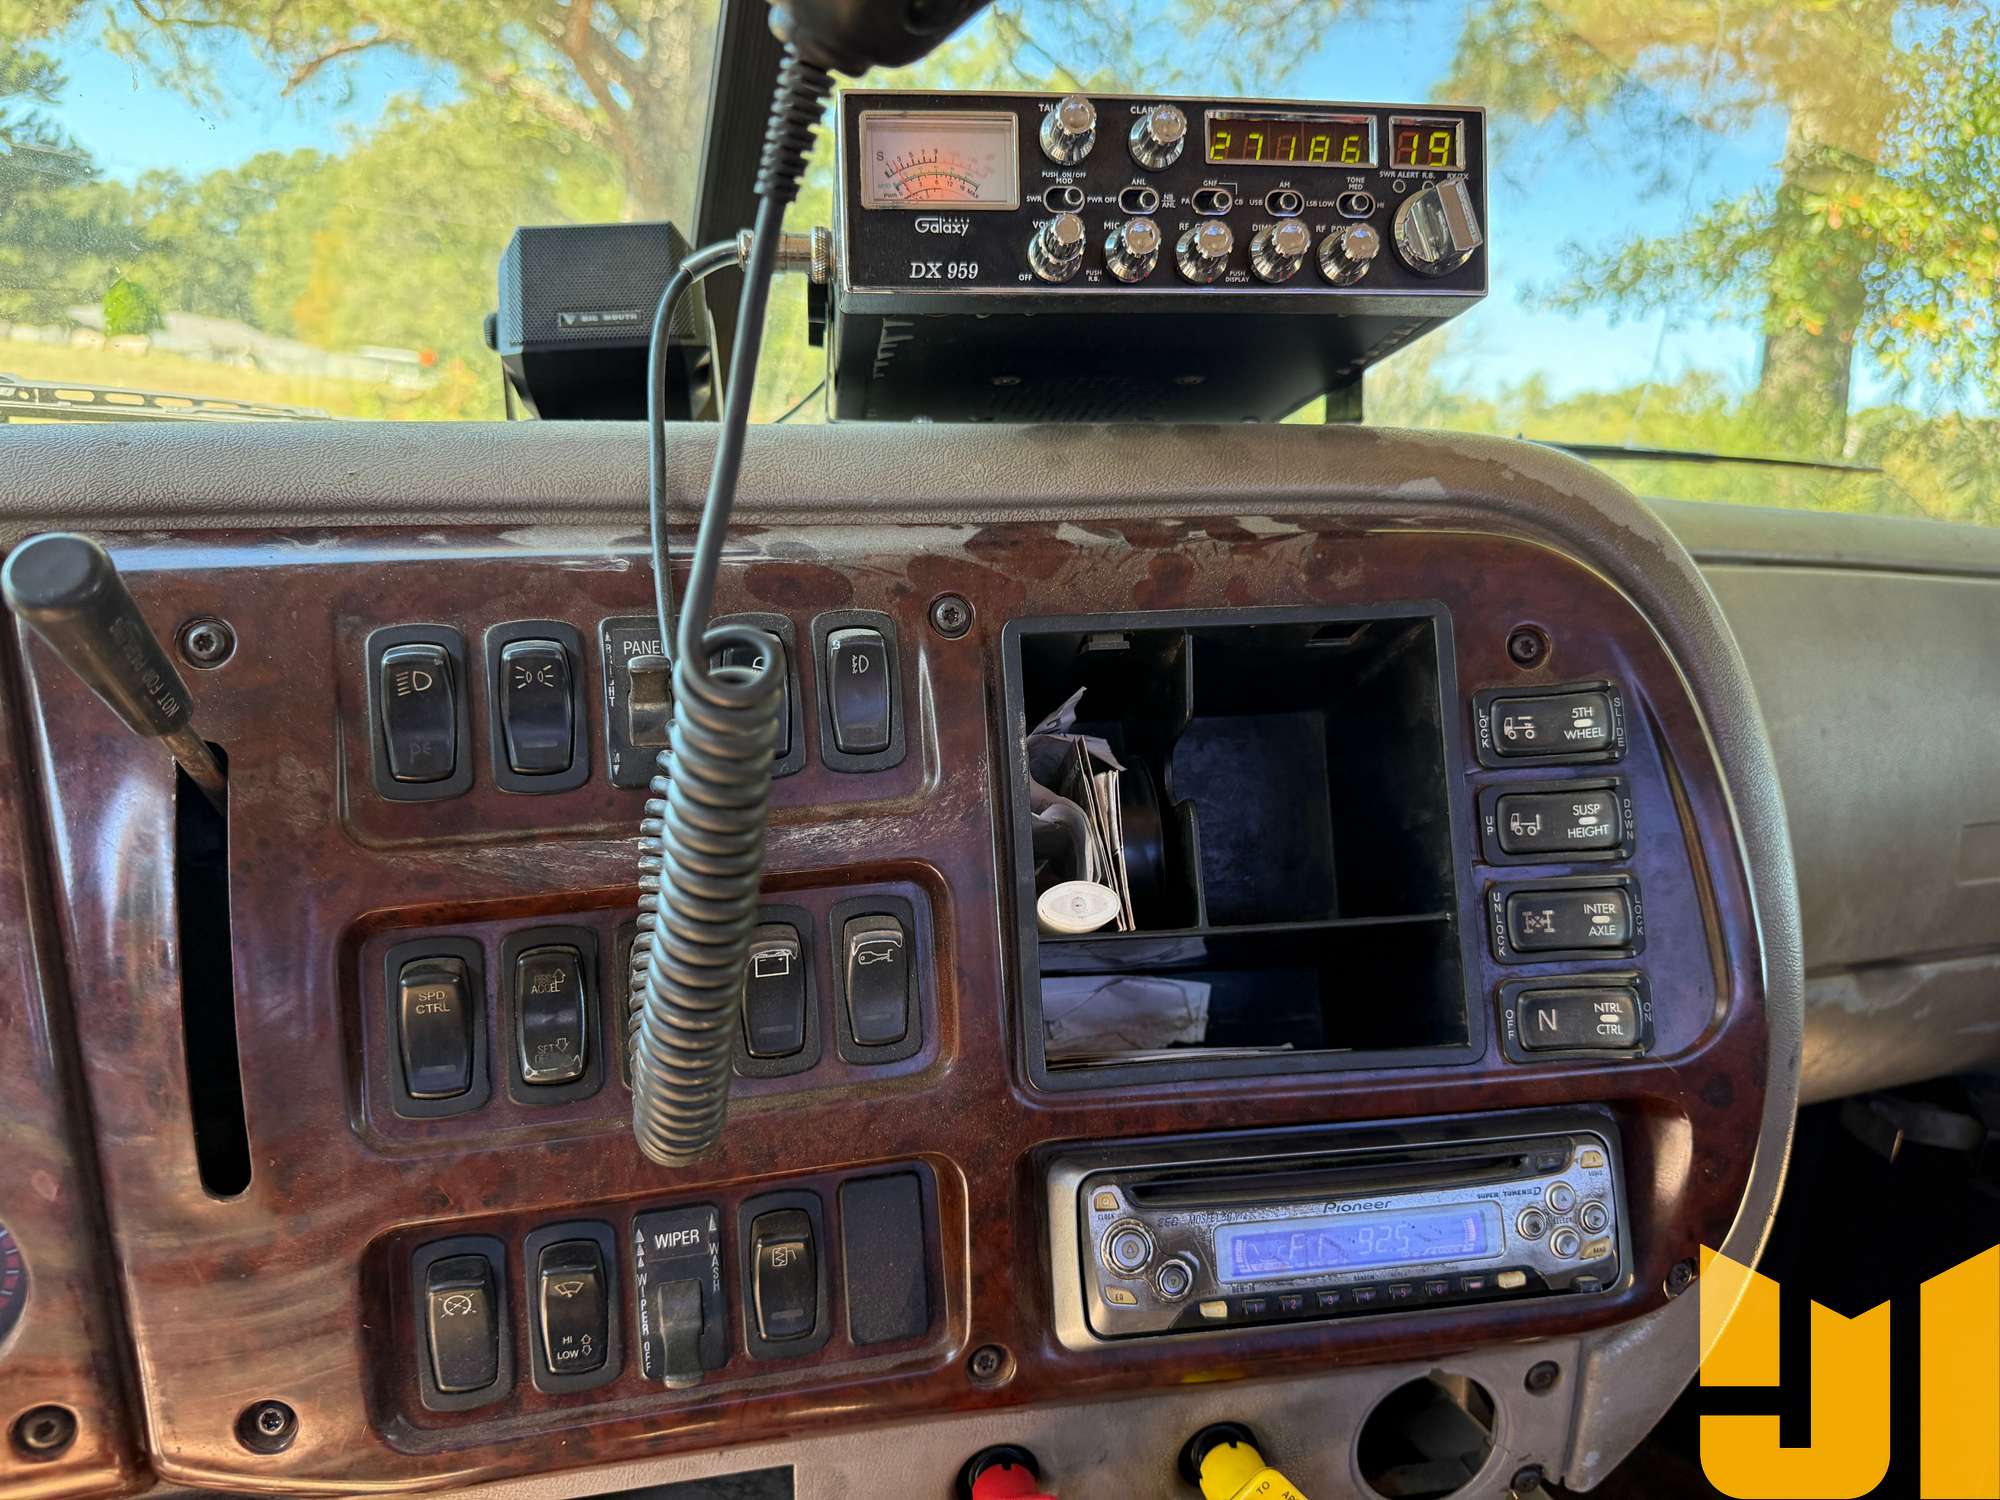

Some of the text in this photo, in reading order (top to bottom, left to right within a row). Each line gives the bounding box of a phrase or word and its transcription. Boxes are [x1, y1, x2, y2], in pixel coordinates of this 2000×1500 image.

[1409, 131, 1450, 167] 19
[1346, 176, 1365, 184] TONE
[1379, 171, 1419, 179] SWR ALERT
[1131, 178, 1146, 186] ANL
[1026, 195, 1042, 203] SWR
[1087, 196, 1103, 204] PWR
[1104, 196, 1117, 204] OFF
[1161, 201, 1176, 209] ANL
[1249, 198, 1263, 206] USB
[1319, 200, 1334, 208] LOW
[915, 216, 970, 236] Galaxy
[909, 262, 979, 280] DX 959
[1018, 274, 1033, 282] OFF
[1571, 707, 1593, 719] 5TH
[1478, 708, 1490, 749] LOCK
[1613, 697, 1625, 747] SLIDE
[1563, 727, 1605, 740] WHEEL
[1572, 804, 1600, 816] SUSP
[1485, 815, 1494, 836] UP
[1623, 799, 1634, 840] DOWN
[1567, 824, 1609, 839] HEIGHT
[1583, 903, 1617, 915] INTER
[1634, 895, 1644, 936] LOCK
[1492, 892, 1506, 957] UNLOCK
[1588, 924, 1617, 937] AXLE
[418, 990, 447, 1002] SPD
[415, 1003, 450, 1015] CTRL
[1594, 1002, 1623, 1013] NTRL
[1643, 1002, 1652, 1022] ON
[1505, 1009, 1515, 1040] OFF
[1537, 1008, 1558, 1032] N
[1596, 1024, 1624, 1035] CTRL
[1322, 1200, 1392, 1214] Pioneer
[654, 1228, 700, 1249] WIPER
[708, 1242, 721, 1292] WASH
[636, 1272, 650, 1337] WIPER
[562, 1334, 573, 1345] HI
[556, 1349, 579, 1361] LOW
[1255, 1480, 1271, 1496] TO
